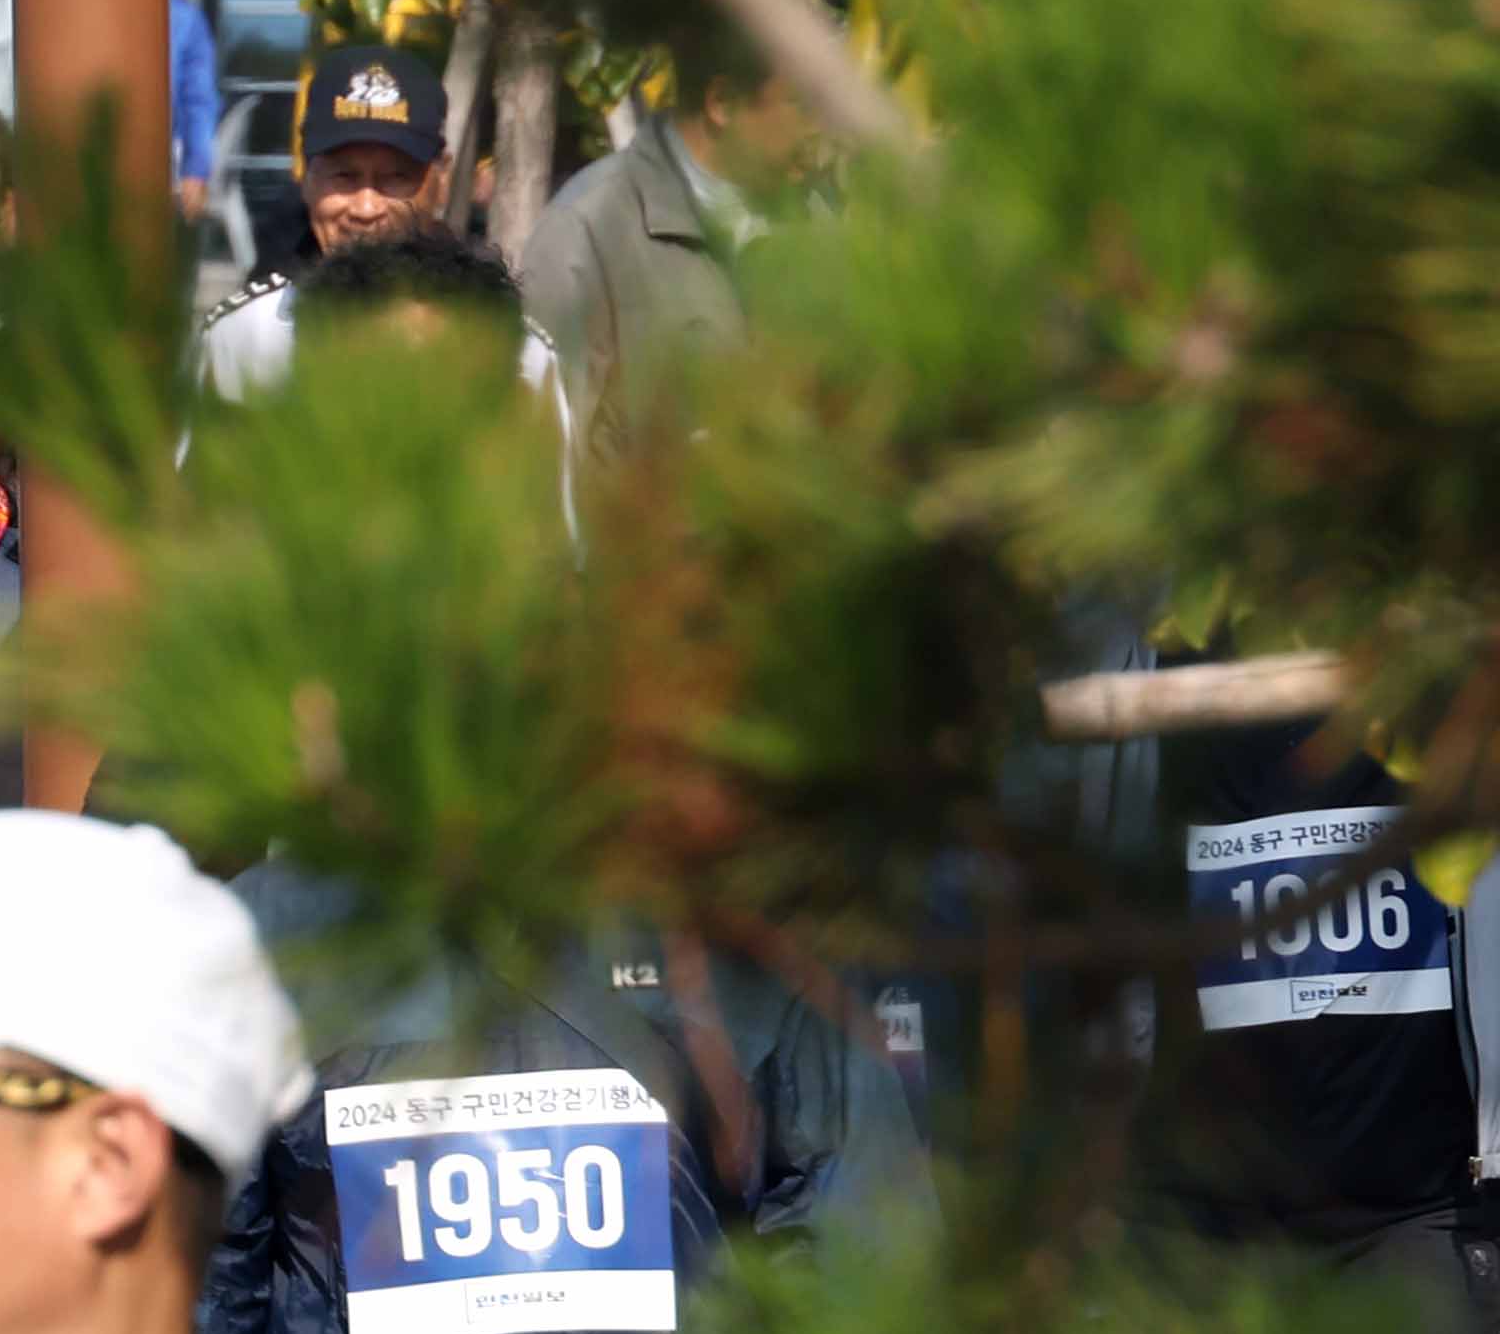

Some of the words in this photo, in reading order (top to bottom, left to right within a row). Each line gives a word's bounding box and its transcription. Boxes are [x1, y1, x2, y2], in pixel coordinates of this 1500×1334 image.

[1197, 836, 1245, 859] 2024
[1250, 829, 1284, 853] 동구
[612, 964, 659, 987] K2
[337, 1101, 396, 1130] 2024
[404, 1097, 454, 1124] 동구
[462, 1084, 655, 1120] 구민건강걷기행사
[383, 1144, 625, 1263] 1950
